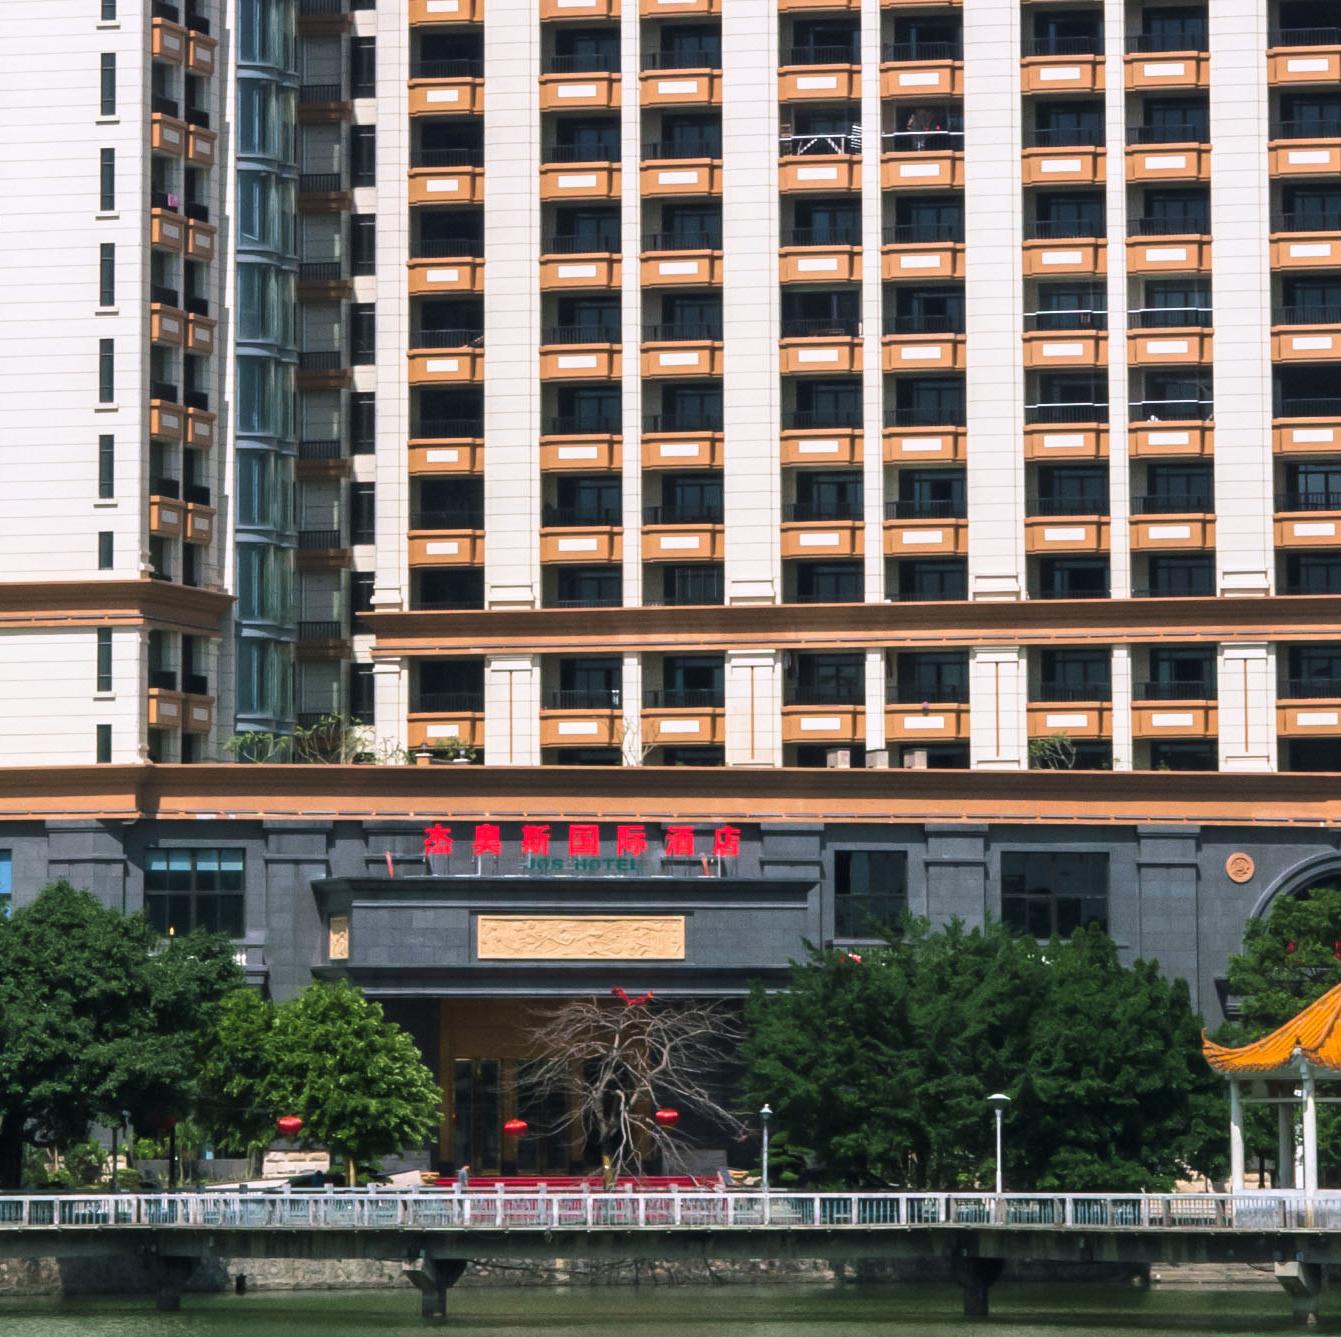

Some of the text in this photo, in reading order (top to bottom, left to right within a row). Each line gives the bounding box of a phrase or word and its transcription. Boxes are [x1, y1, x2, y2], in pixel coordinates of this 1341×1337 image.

[424, 824, 741, 856] 杰奥斯国际酒店
[525, 858, 638, 871] JOS HOTEL
